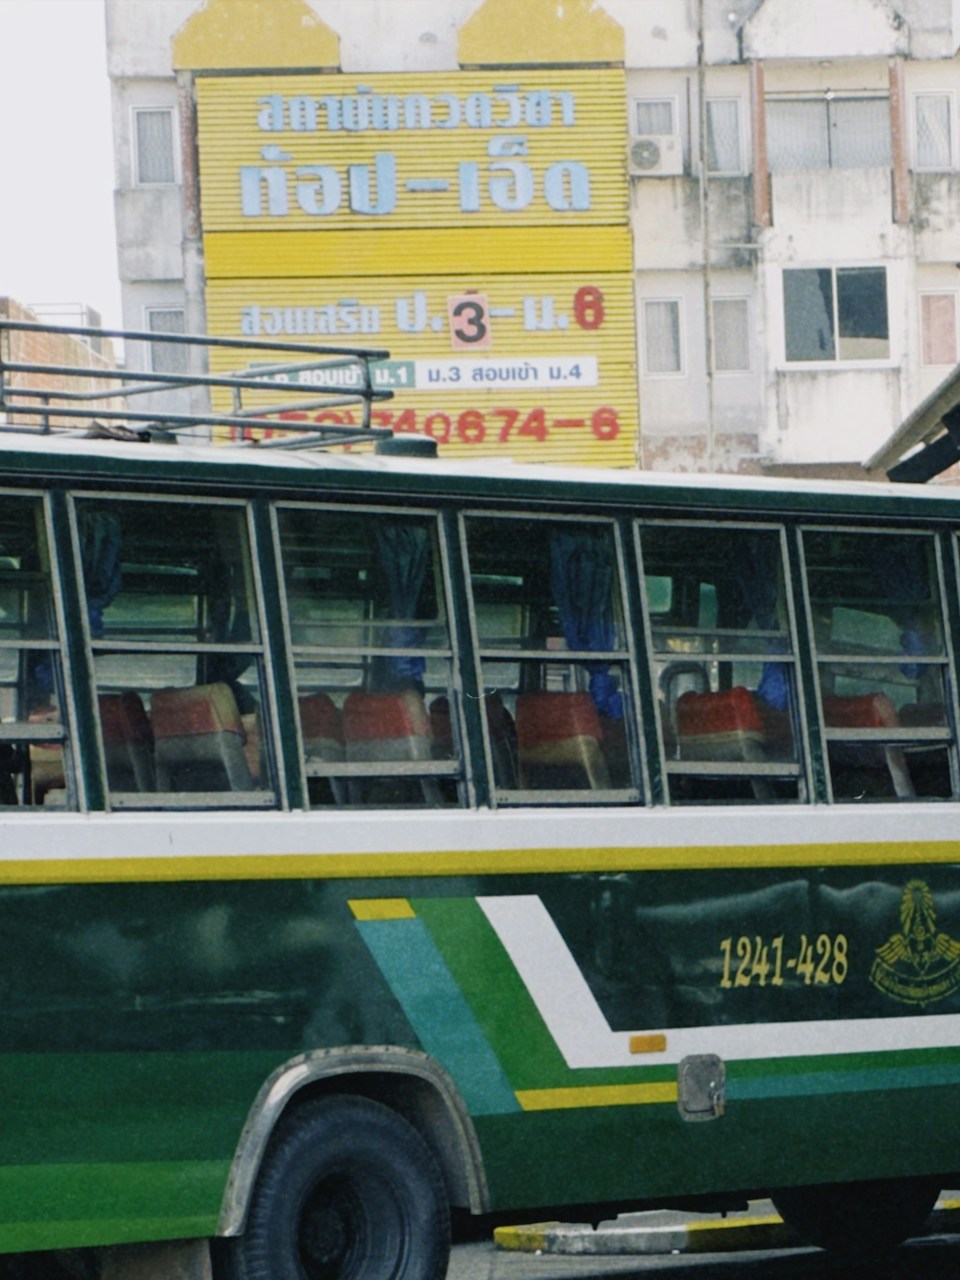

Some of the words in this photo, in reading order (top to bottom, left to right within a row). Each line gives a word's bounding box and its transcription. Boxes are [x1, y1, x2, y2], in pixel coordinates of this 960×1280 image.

[257, 84, 576, 132] สถาบันกวดวิชา
[375, 367, 408, 384] ม.1
[428, 365, 461, 383] ม.3
[472, 359, 538, 382] สอบเข้า
[549, 363, 582, 380] ม.4
[719, 933, 849, 989] 1241-428
